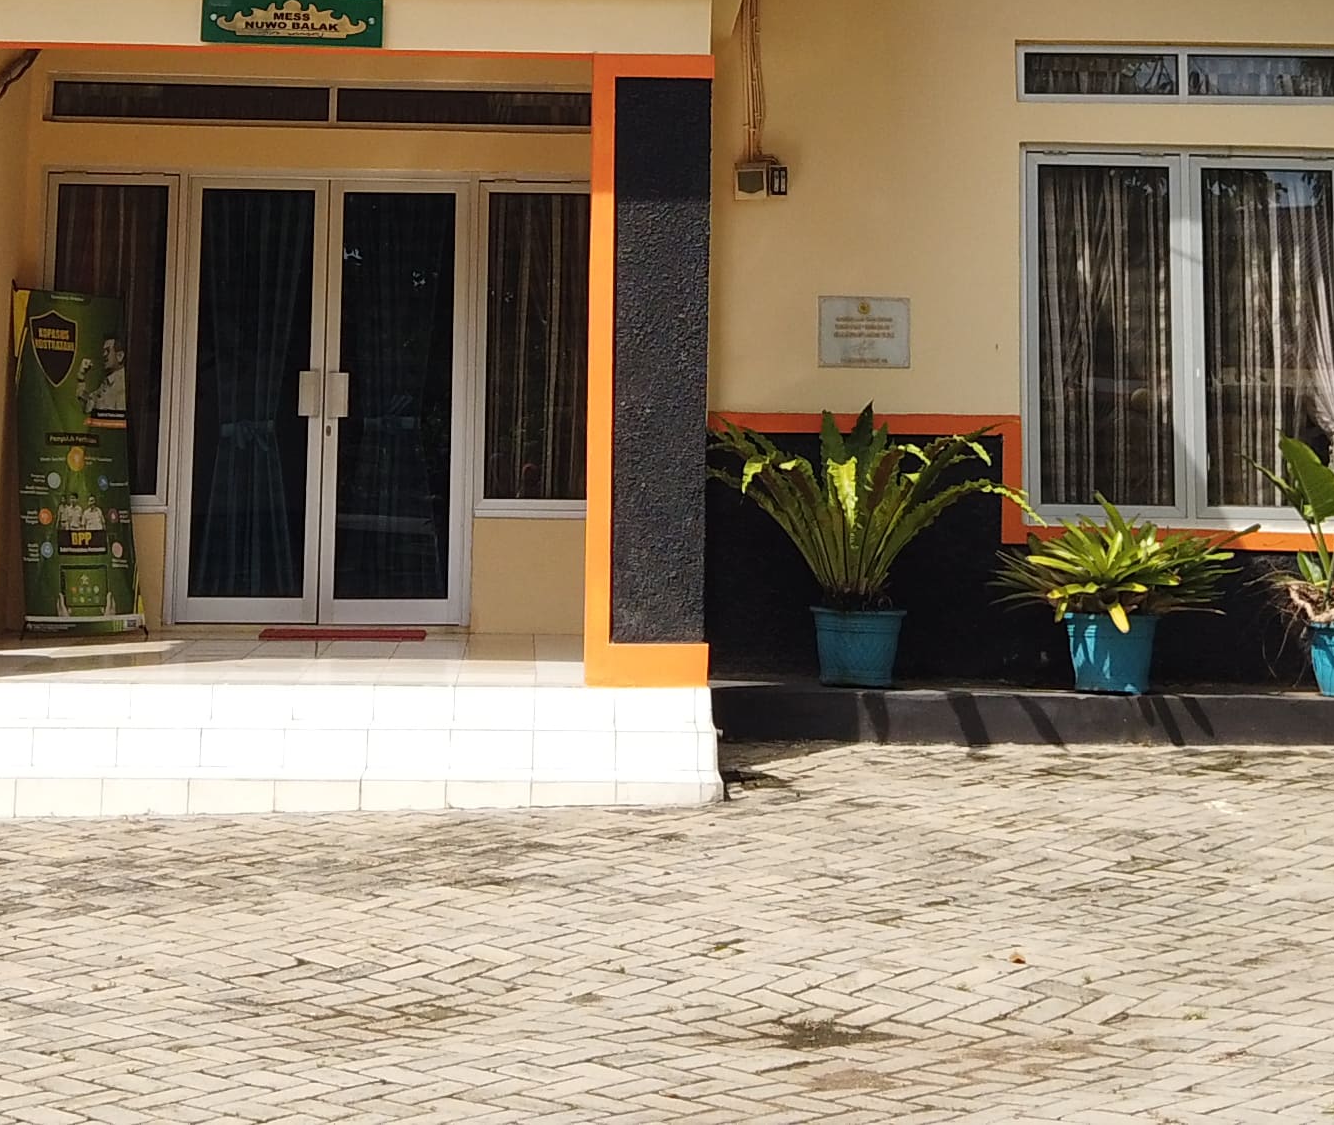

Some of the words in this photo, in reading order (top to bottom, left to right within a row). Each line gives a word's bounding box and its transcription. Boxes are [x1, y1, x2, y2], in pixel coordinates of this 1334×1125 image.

[273, 12, 310, 22] MESS
[244, 21, 287, 30] NUWO
[291, 22, 339, 32] BALAK
